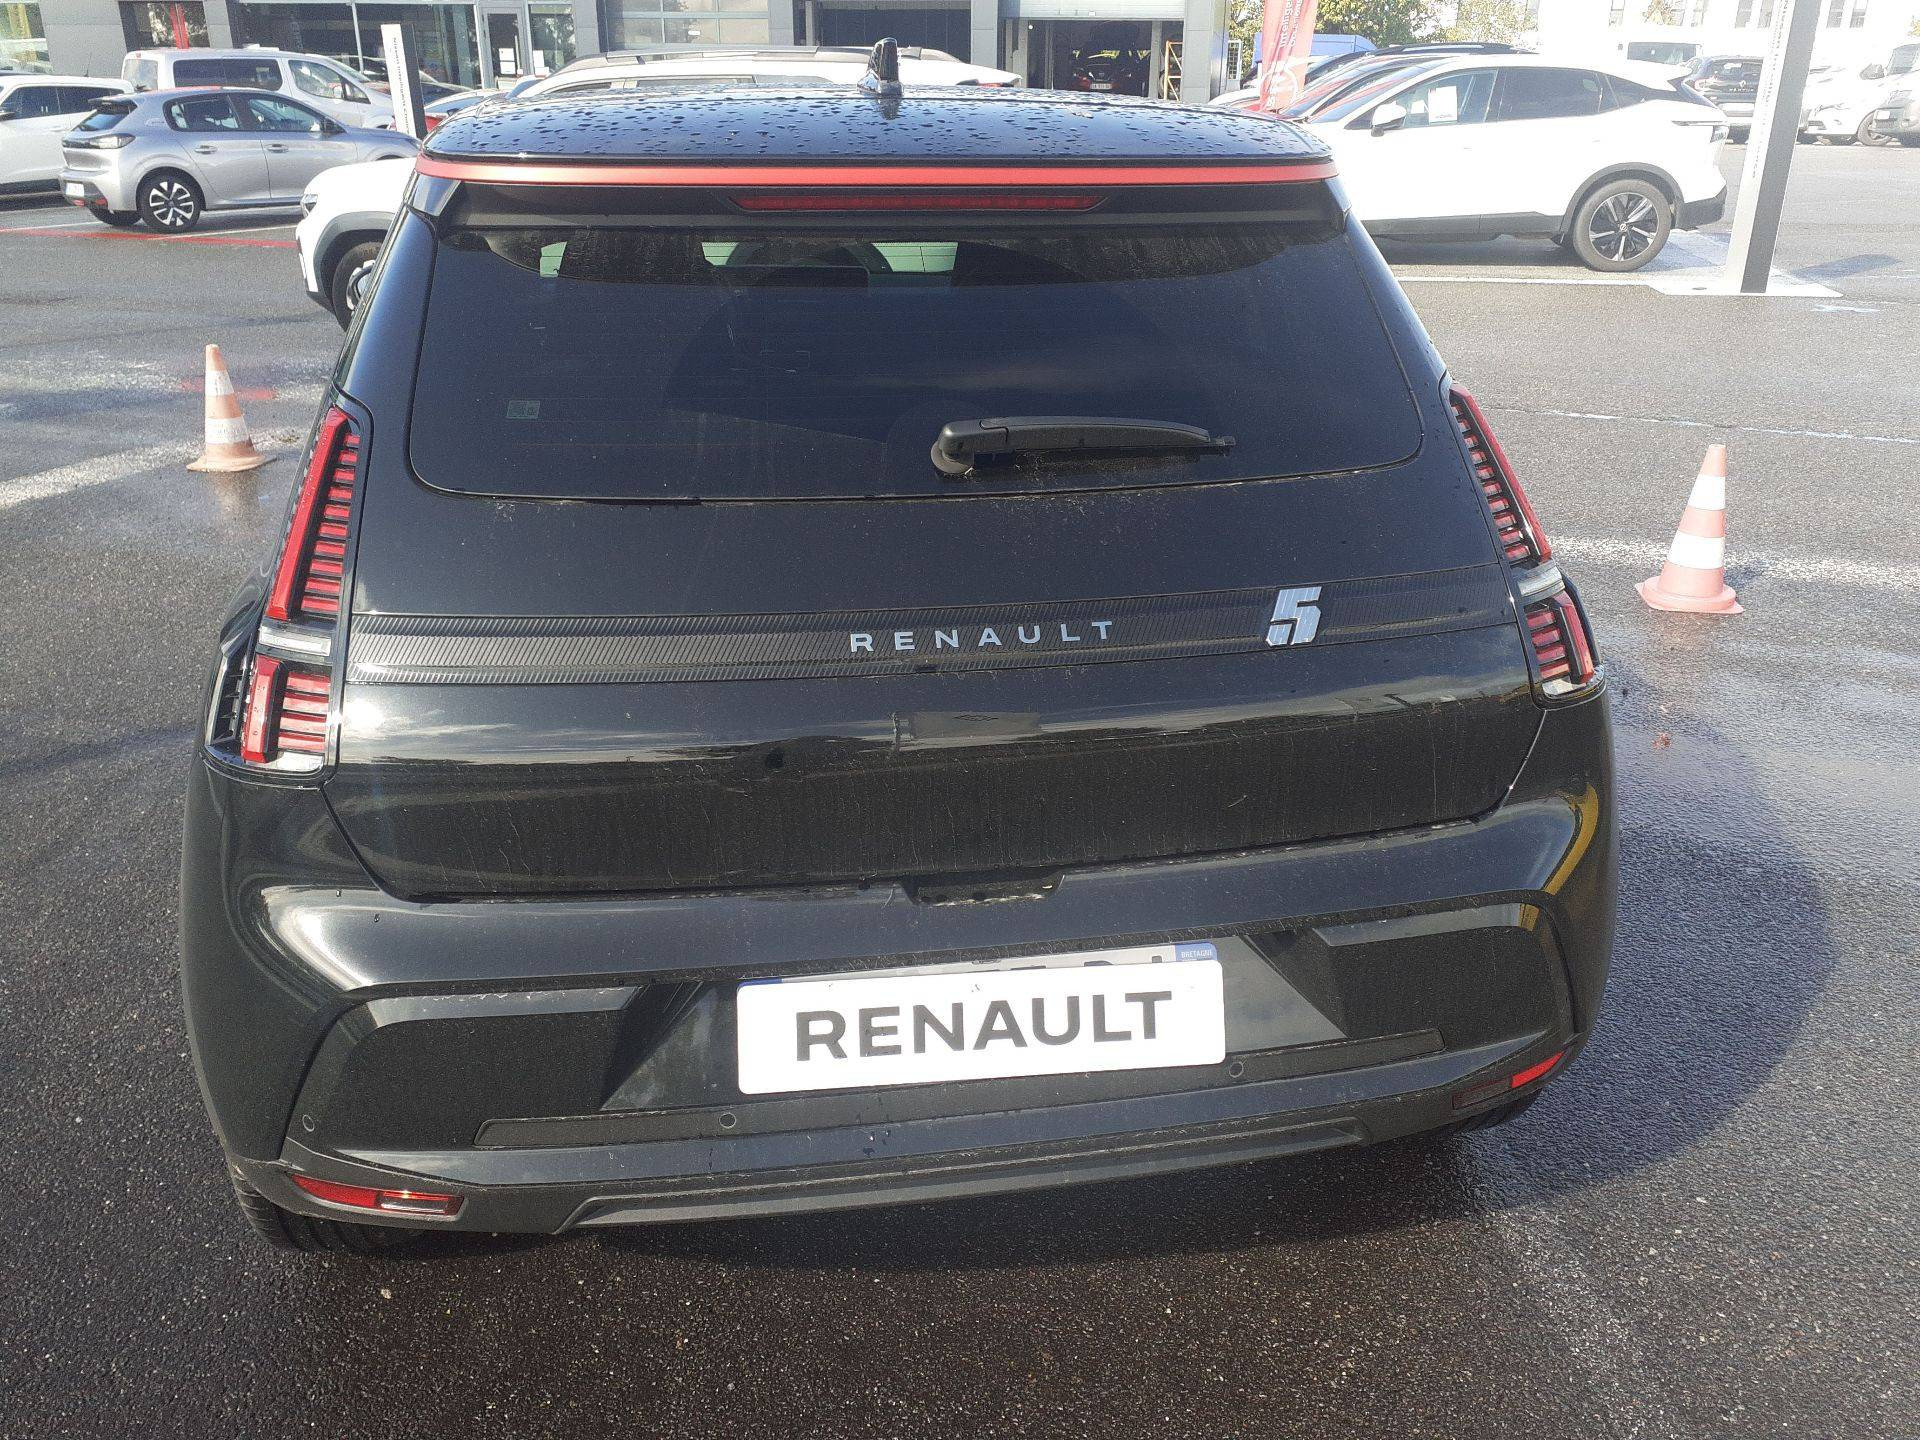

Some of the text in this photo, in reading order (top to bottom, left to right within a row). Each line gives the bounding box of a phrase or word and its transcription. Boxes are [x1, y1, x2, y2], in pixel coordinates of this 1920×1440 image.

[850, 620, 1112, 652] RENAULT
[1266, 586, 1322, 646] 5
[795, 990, 1173, 1062] RENAULT
